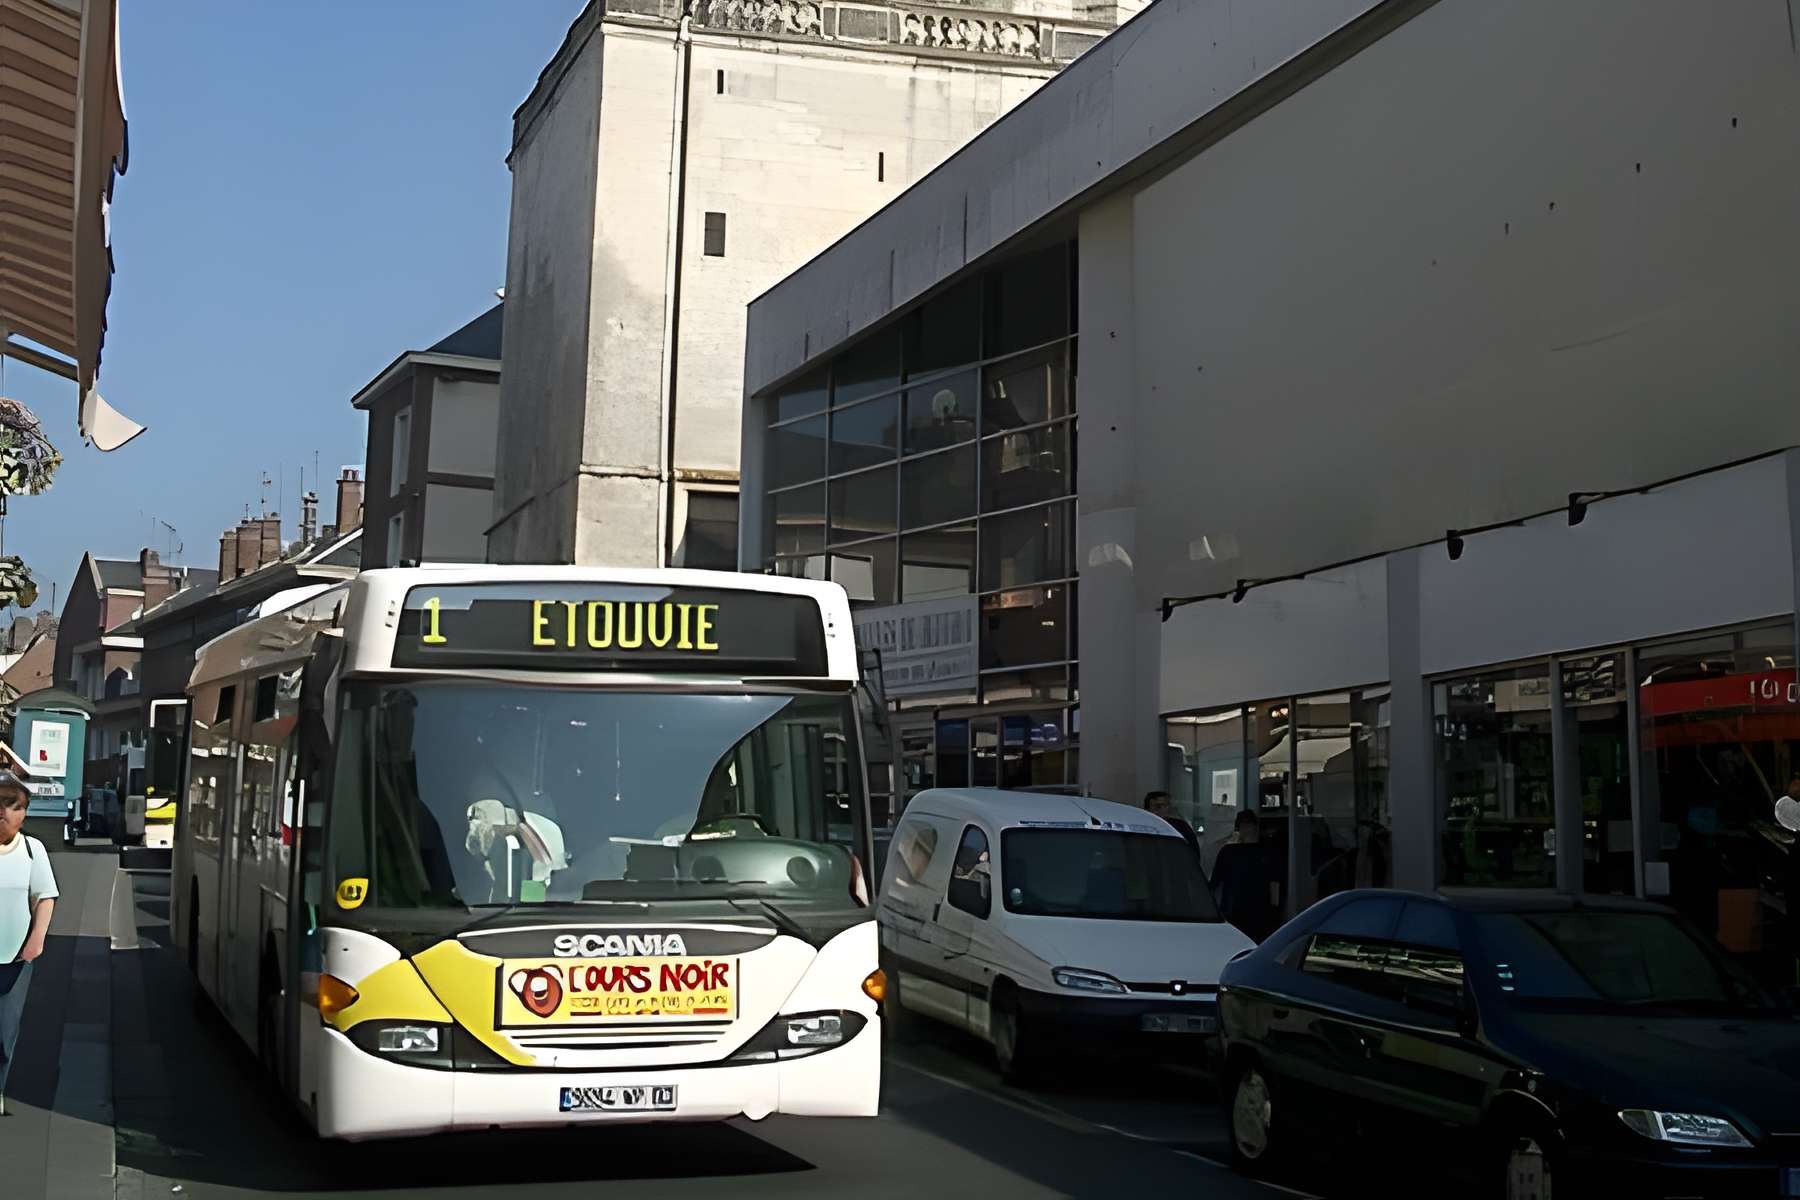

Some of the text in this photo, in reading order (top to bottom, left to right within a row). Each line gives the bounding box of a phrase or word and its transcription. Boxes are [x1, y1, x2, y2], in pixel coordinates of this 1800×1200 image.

[422, 597, 719, 650] 1 ETOUVIE
[553, 933, 687, 957] SCANIA
